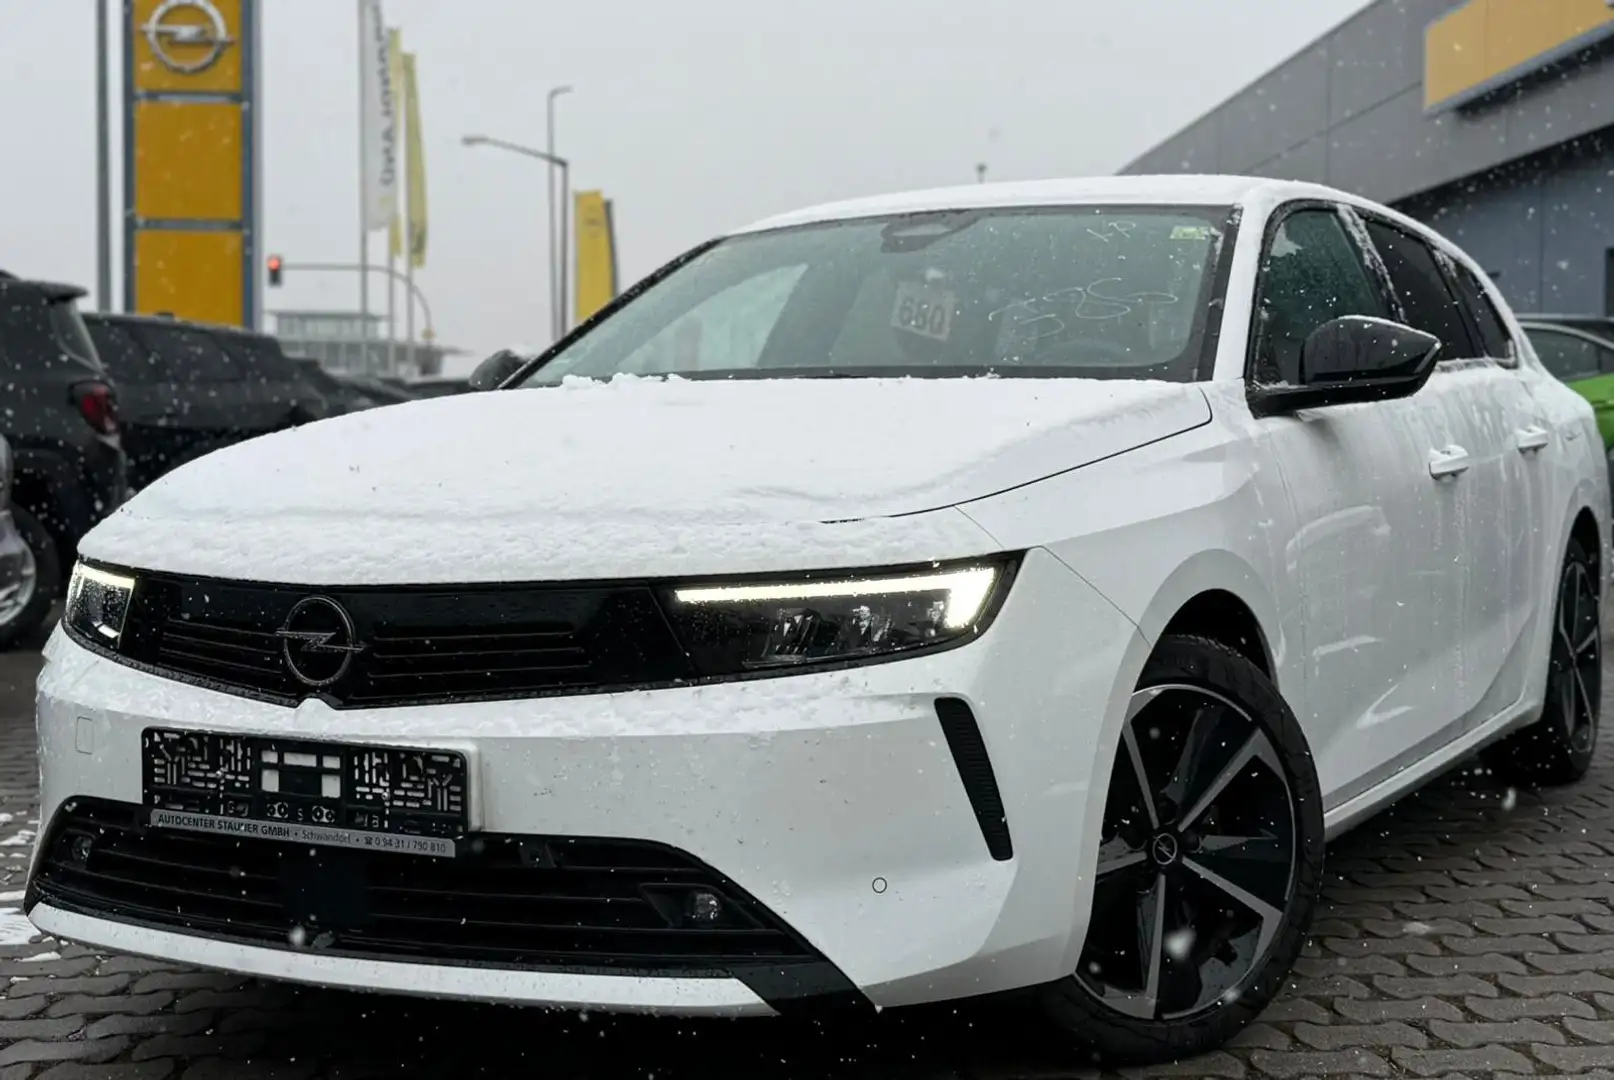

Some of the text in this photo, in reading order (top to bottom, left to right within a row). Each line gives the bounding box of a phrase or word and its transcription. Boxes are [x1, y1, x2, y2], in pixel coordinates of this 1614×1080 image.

[158, 814, 215, 829] AUTOCENTER
[261, 825, 290, 837] GMBH
[302, 830, 350, 843] Schwandorf
